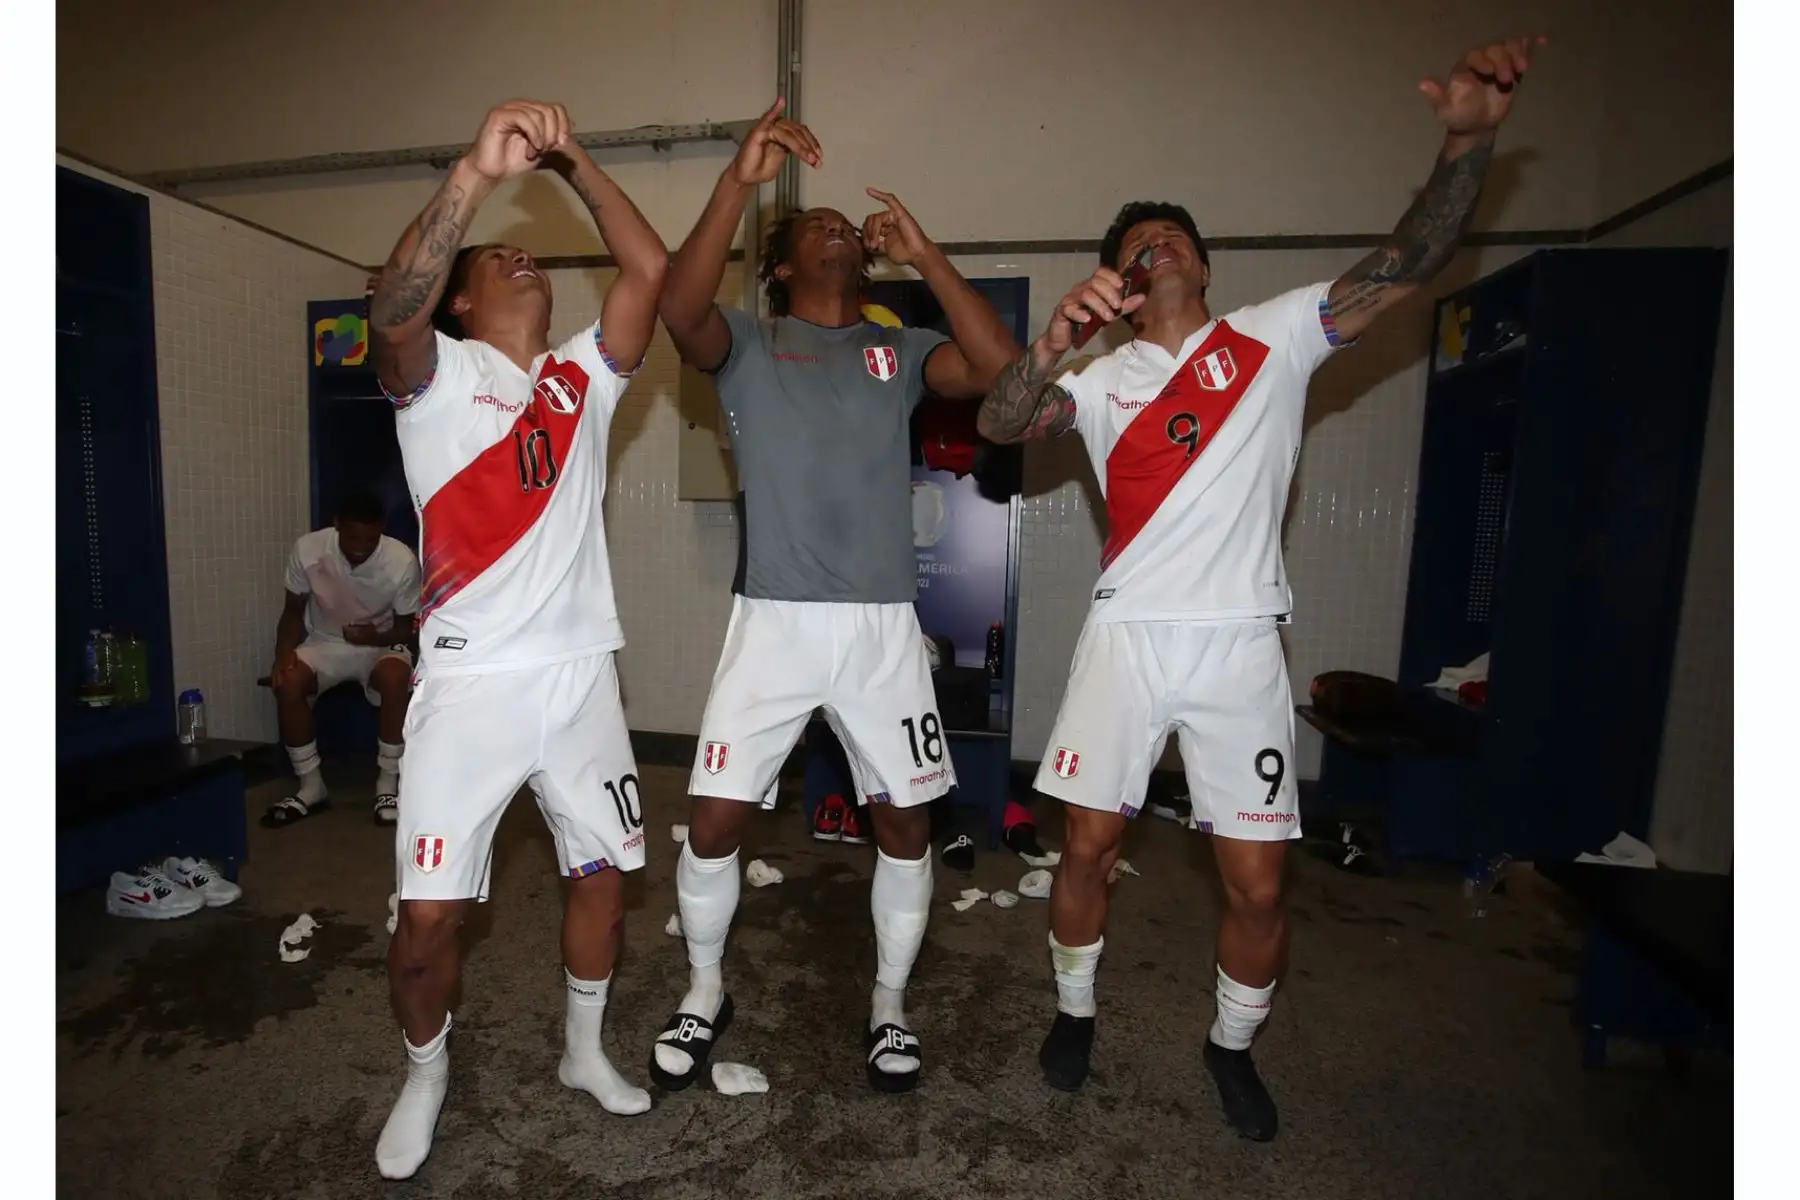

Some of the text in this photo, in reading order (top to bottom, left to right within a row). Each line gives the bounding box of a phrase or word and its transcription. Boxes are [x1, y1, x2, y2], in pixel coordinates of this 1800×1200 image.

[513, 428, 557, 492] 10
[1166, 412, 1200, 461] 9
[917, 562, 968, 576] MERICA
[901, 712, 943, 768] 18
[1254, 748, 1285, 805] 9
[603, 773, 644, 834] 10
[1237, 811, 1296, 823] marathon
[673, 1018, 699, 1042] 18
[885, 1028, 905, 1050] 18
